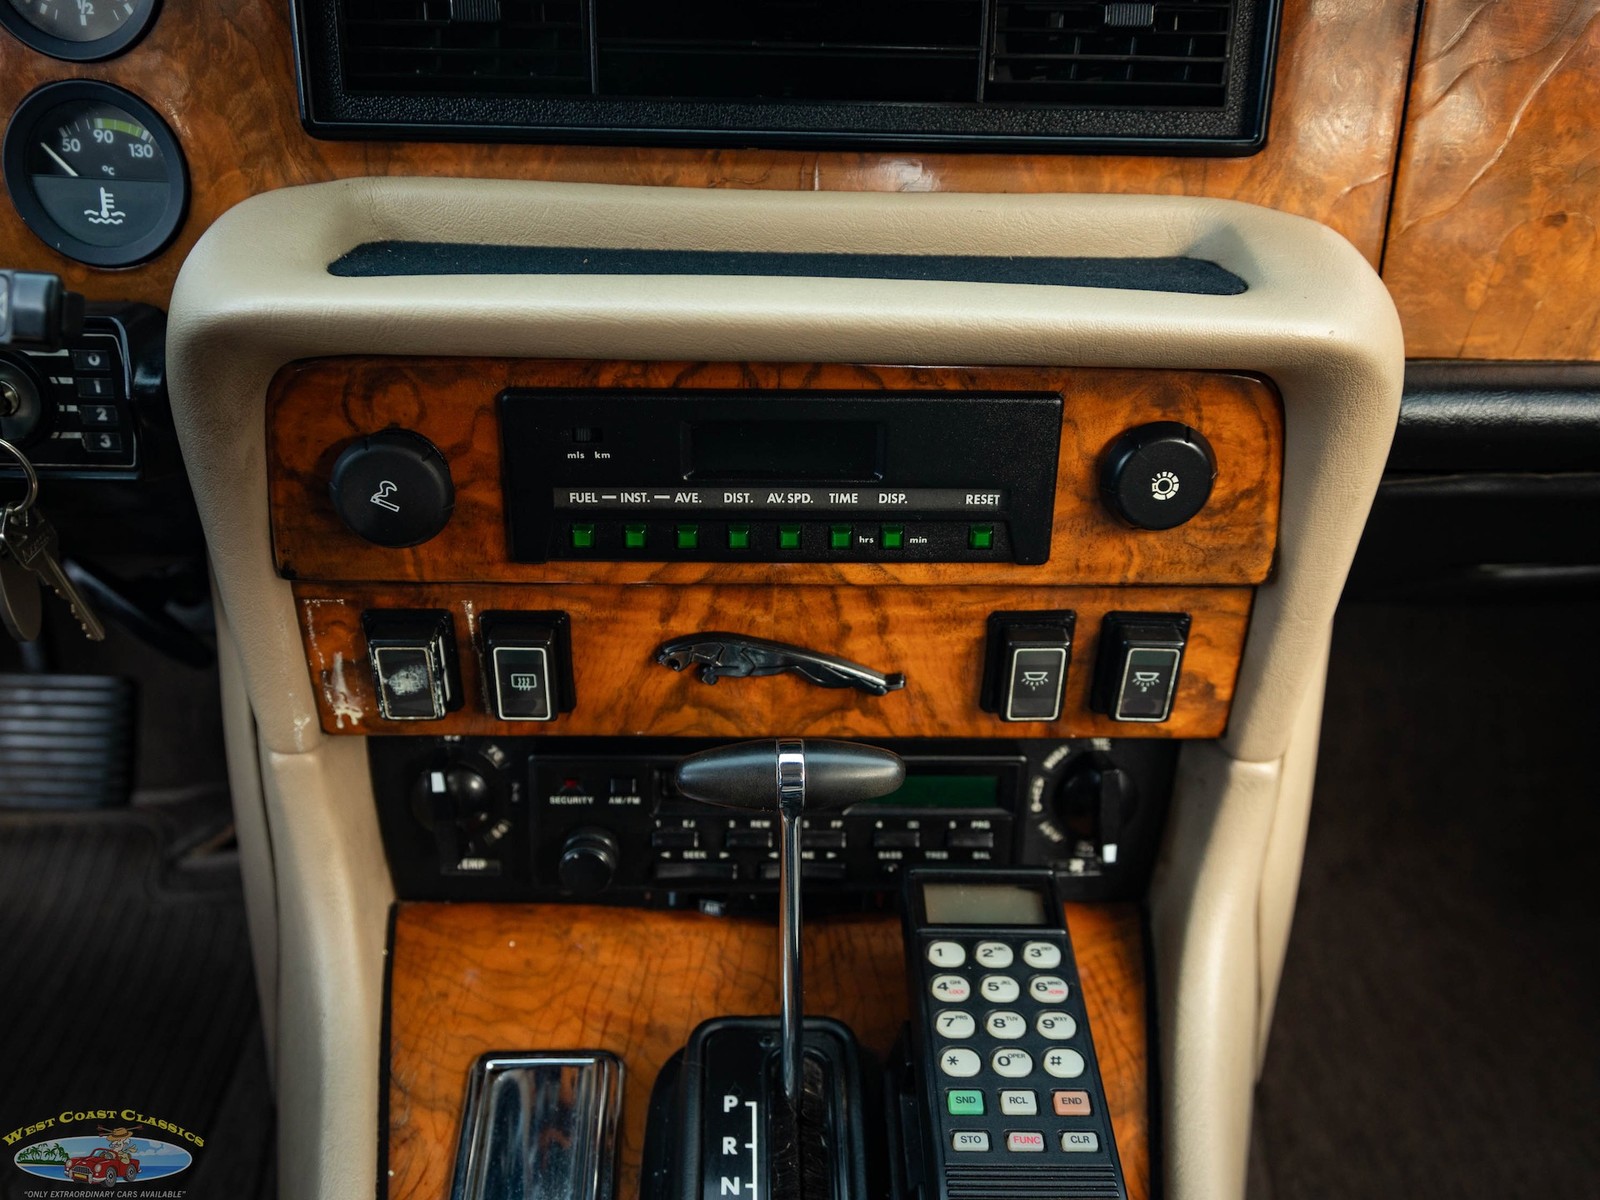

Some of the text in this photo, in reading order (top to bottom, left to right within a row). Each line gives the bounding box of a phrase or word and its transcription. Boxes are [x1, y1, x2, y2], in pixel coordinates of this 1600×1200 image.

[93, 129, 114, 144] 90
[62, 138, 81, 152] 50
[128, 143, 153, 158] 130
[88, 354, 100, 366] 0
[93, 380, 102, 393] 1
[96, 408, 108, 421] 2
[100, 435, 111, 448] 3
[567, 451, 611, 459] mls km
[569, 492, 1000, 505] FUEL INST. AVE. DIST. AV. SPD. TIME DISP. RESET
[859, 536, 928, 544] hrs min
[549, 796, 594, 804] SECURITY
[608, 796, 641, 804] AM/FM
[682, 851, 707, 859] SEEK
[935, 948, 943, 957] 1
[982, 949, 994, 958] 2
[1030, 949, 1043, 958] 3
[937, 982, 949, 991] 4
[987, 982, 1000, 992] 5
[1035, 982, 1048, 992] 6
[942, 1017, 955, 1028] 7
[993, 1018, 1007, 1029] 8
[1042, 1019, 1056, 1030] 9
[723, 1095, 739, 1113] P
[955, 1096, 976, 1104] SND
[1009, 1096, 1029, 1104] RCL
[1061, 1097, 1082, 1105] END
[960, 1136, 982, 1144] STO
[1013, 1136, 1041, 1145] FUNC
[1070, 1136, 1090, 1144] CLR
[722, 1137, 738, 1155] R
[720, 1176, 740, 1196] N
